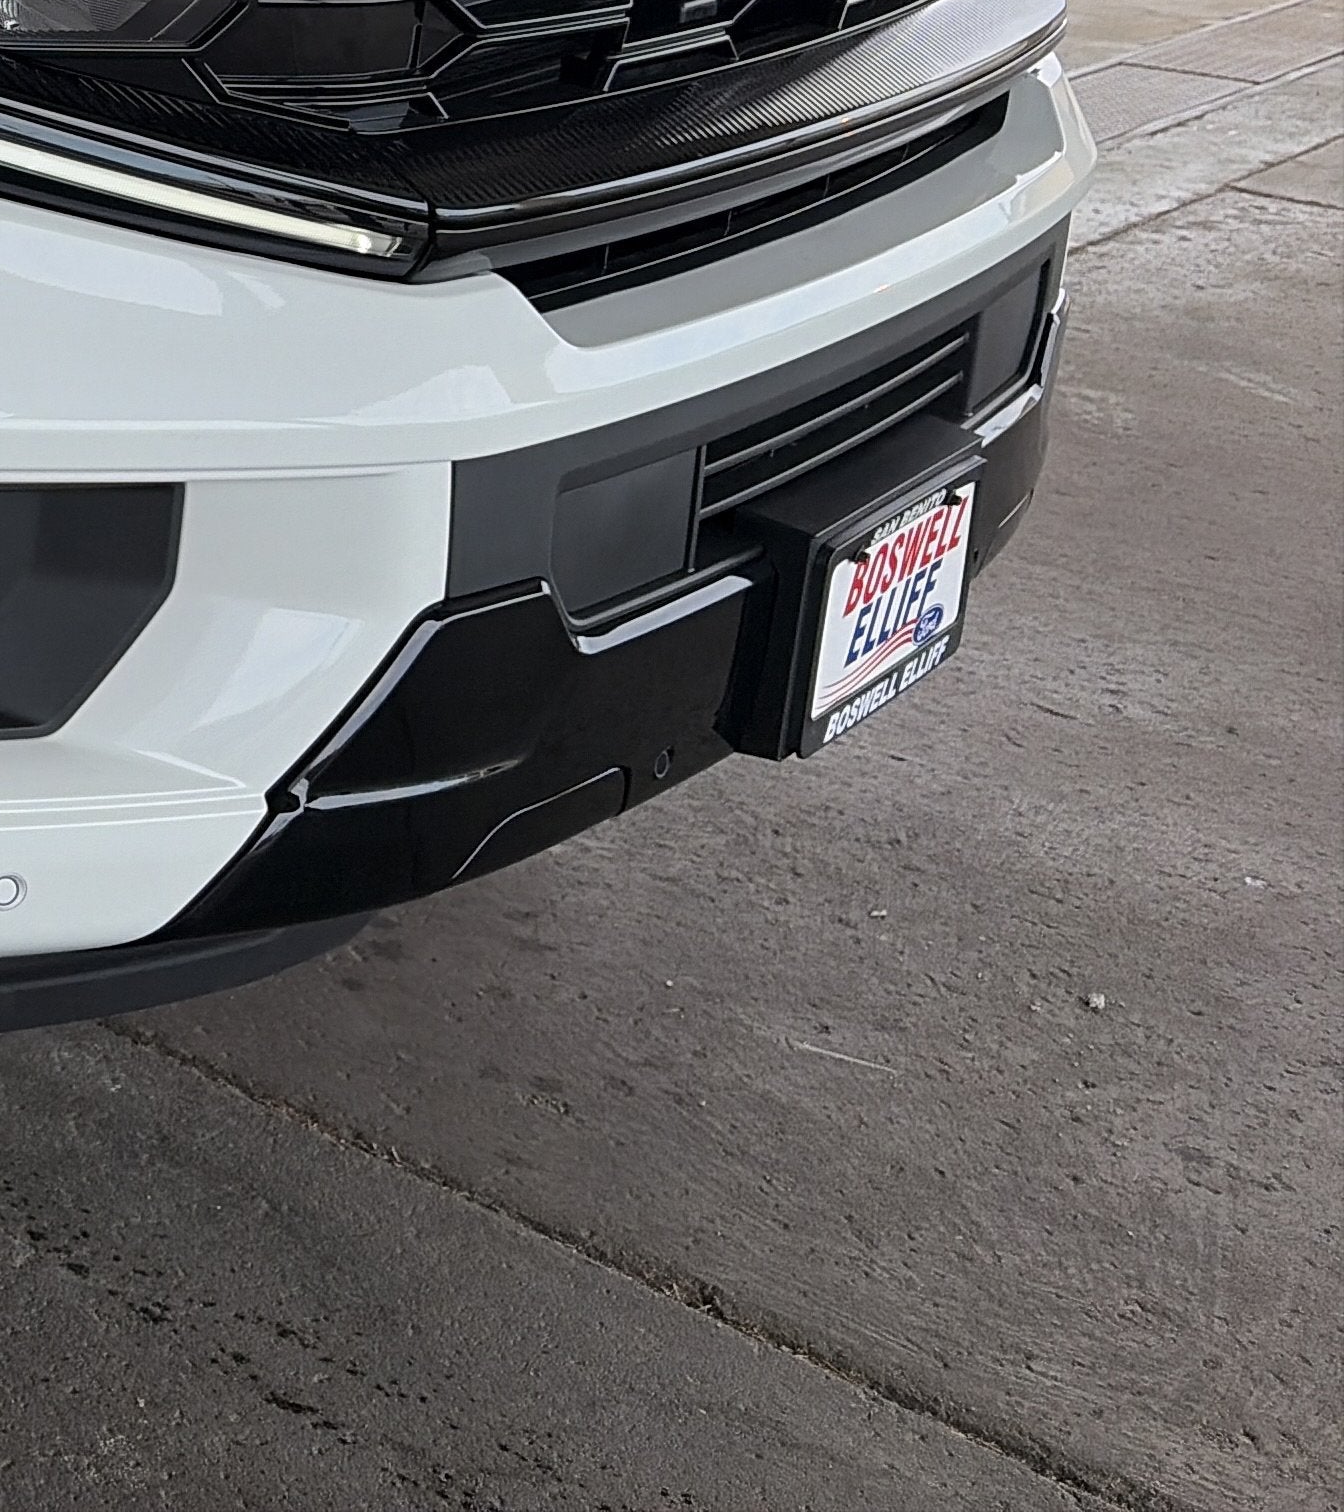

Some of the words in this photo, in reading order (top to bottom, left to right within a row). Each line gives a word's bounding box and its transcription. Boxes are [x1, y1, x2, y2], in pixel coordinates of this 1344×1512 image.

[843, 495, 967, 618] BOSWELL
[871, 518, 899, 545] SAN
[900, 489, 947, 528] BENITO
[844, 560, 943, 668] ELLIFF
[824, 674, 897, 744] BOSWELL
[900, 635, 949, 686] ELLIFF
